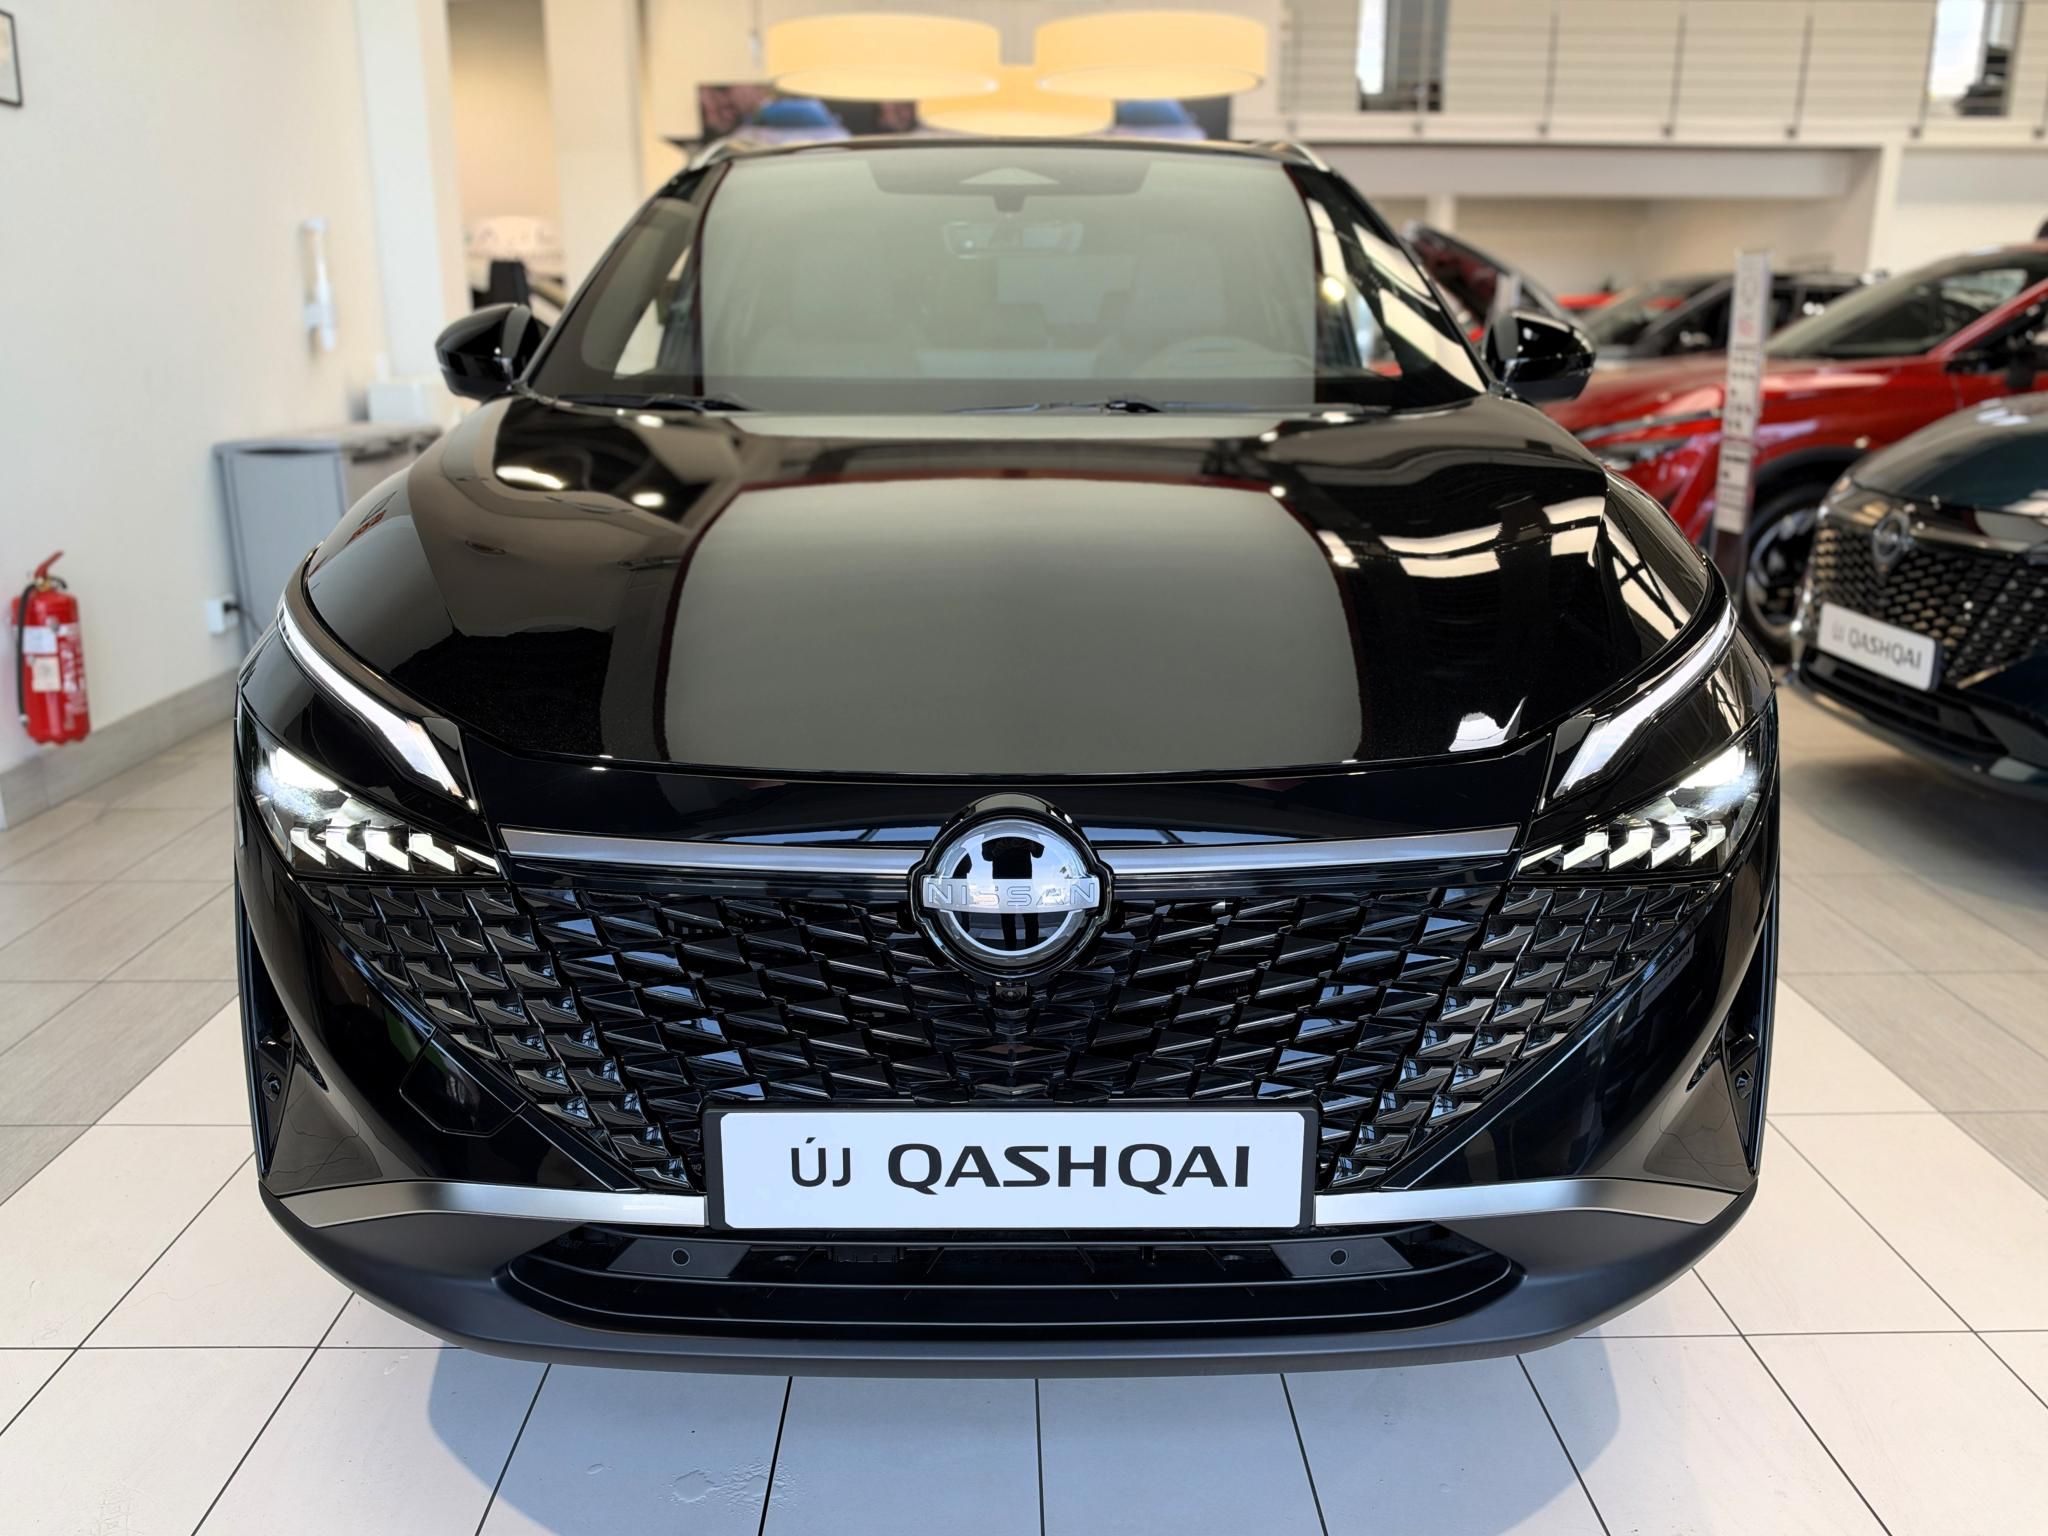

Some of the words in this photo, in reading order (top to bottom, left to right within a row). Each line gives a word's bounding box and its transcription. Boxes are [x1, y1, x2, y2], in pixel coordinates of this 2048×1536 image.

[1848, 627, 1923, 670] QASHQAI
[927, 882, 1095, 906] NISSAN
[790, 1136, 851, 1188] ÚJ
[887, 1143, 1249, 1195] QASHQAI
